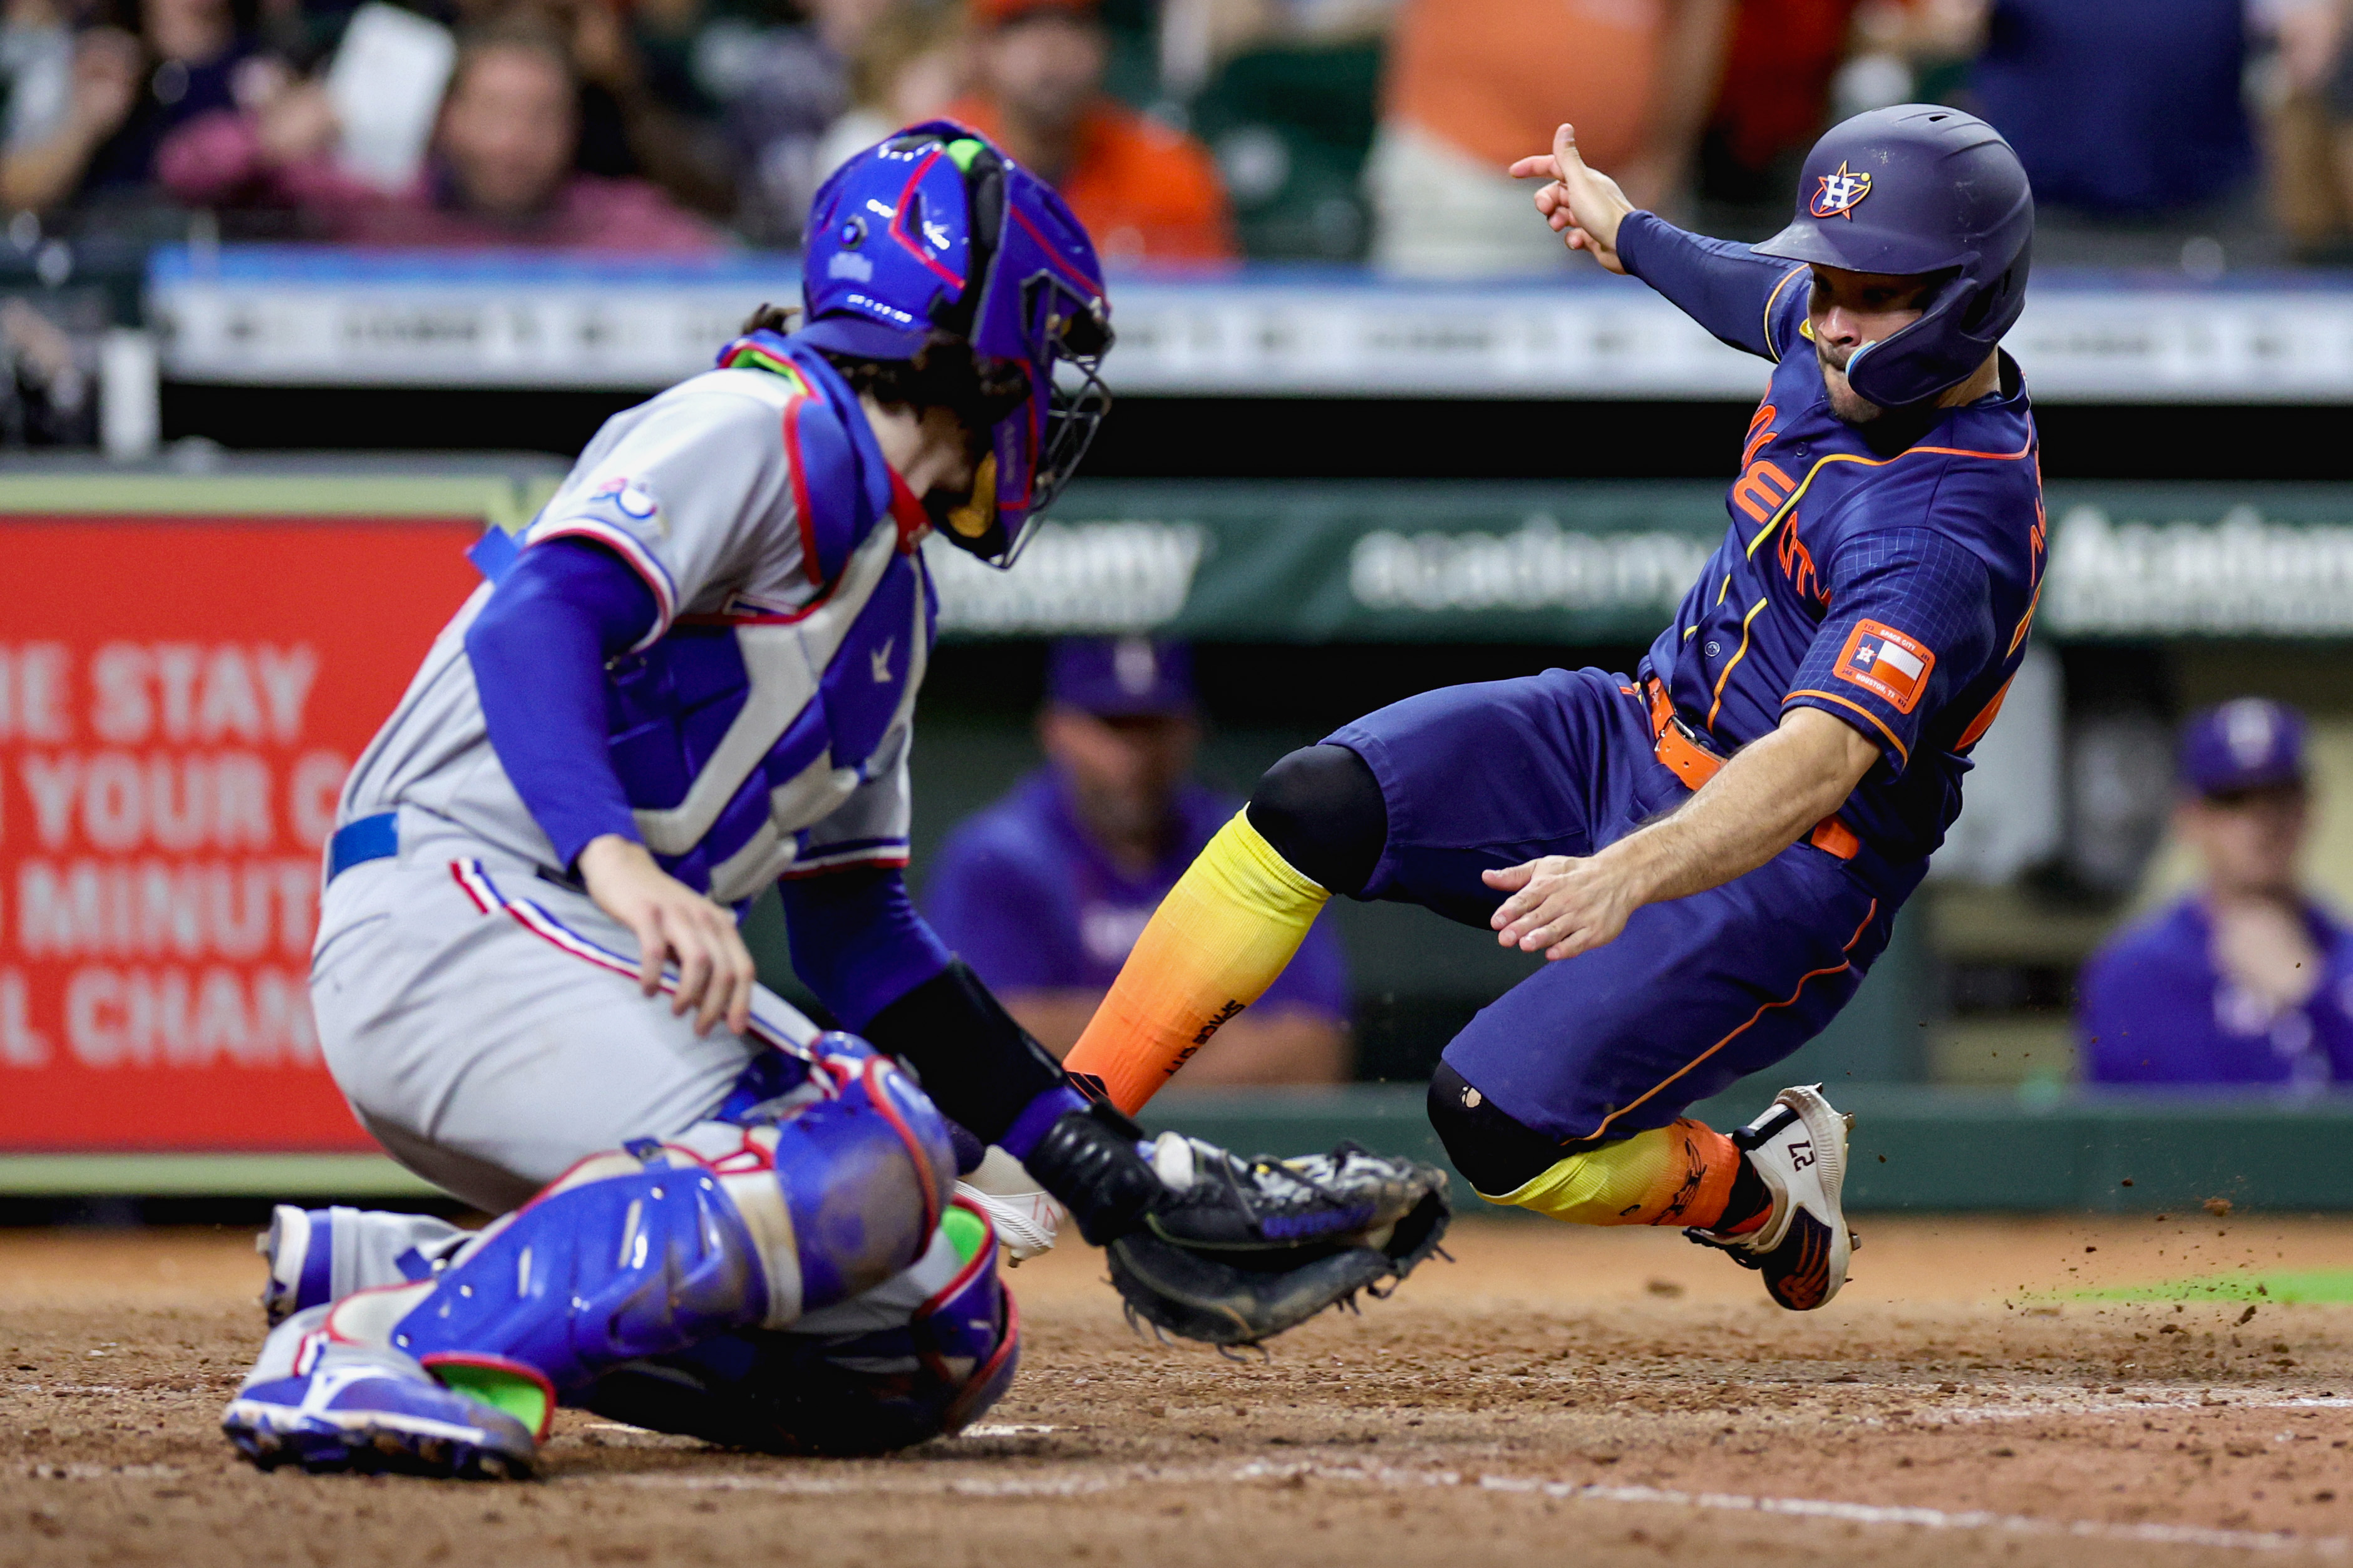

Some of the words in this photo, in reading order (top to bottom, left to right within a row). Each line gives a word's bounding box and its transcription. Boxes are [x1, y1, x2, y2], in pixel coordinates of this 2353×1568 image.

[1880, 629, 1901, 644] SPACE
[1901, 639, 1917, 652] CITY
[91, 640, 318, 741] STAY
[1855, 673, 1887, 695] HOUSTON,
[1887, 689, 1897, 699] TX
[25, 753, 269, 850] YOUR
[1787, 1139, 1817, 1172] 27
